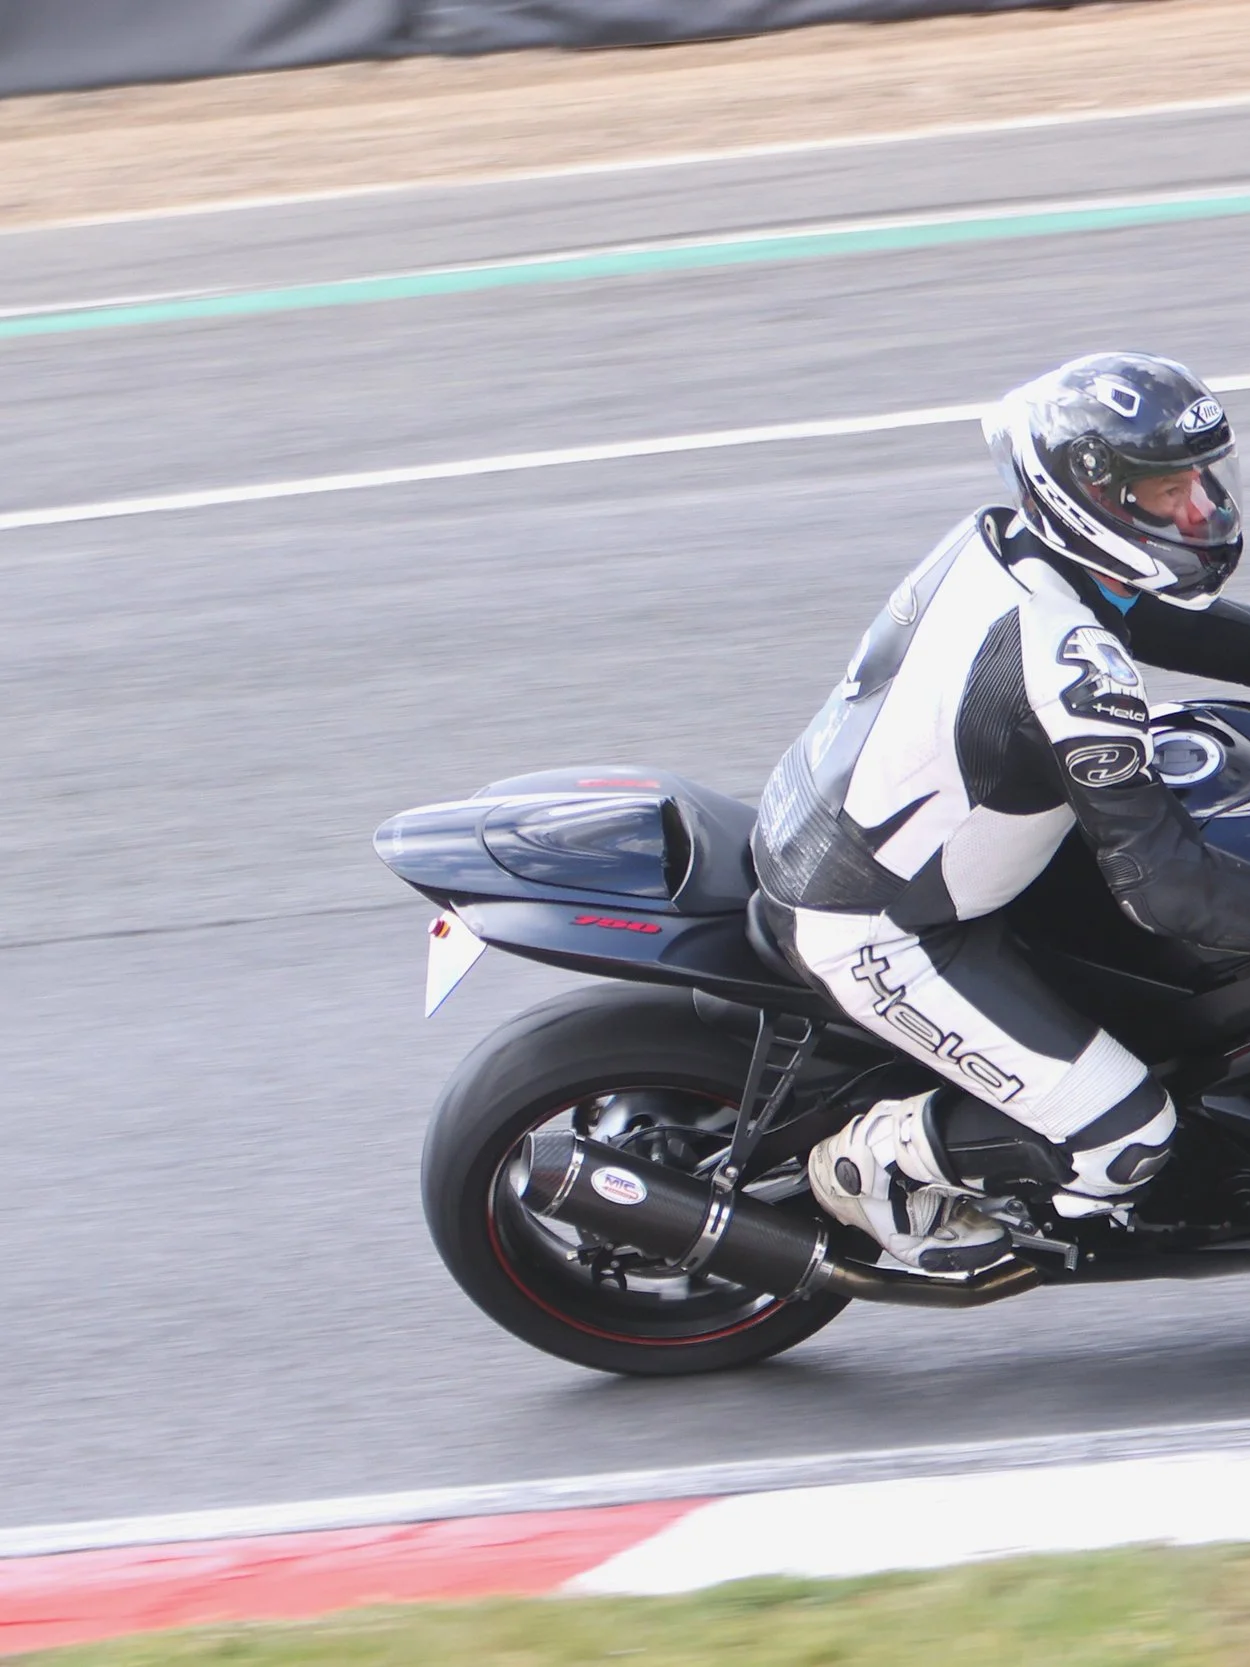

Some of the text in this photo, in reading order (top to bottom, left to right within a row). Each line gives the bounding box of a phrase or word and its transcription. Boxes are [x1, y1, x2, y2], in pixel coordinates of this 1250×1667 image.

[1189, 404, 1220, 429] X-lite
[1092, 703, 1147, 722] Held
[570, 914, 663, 934] 750
[851, 946, 1024, 1103] Held
